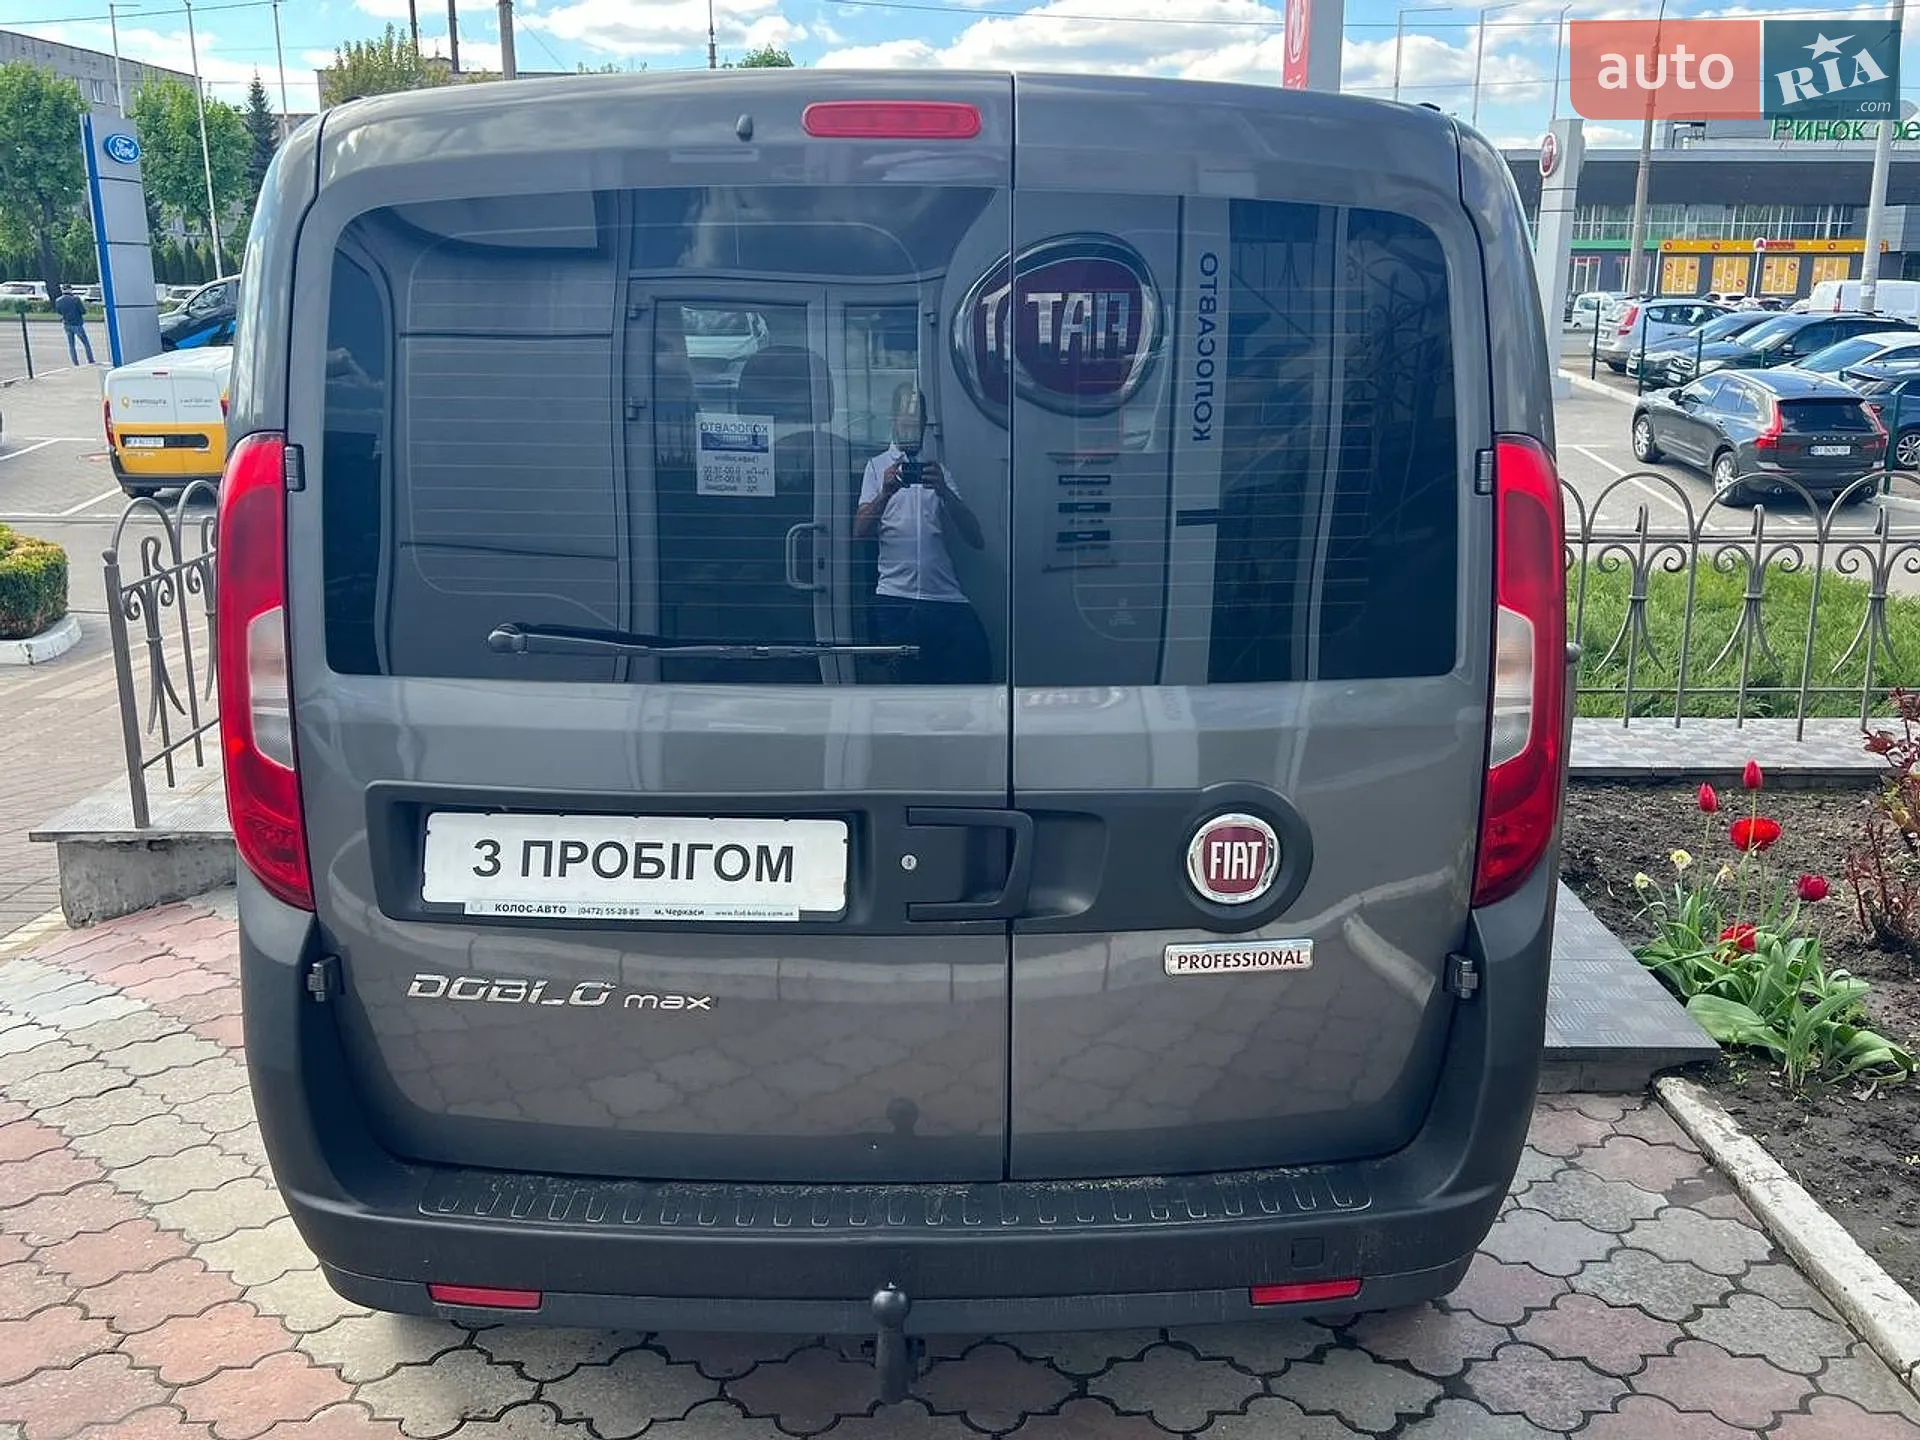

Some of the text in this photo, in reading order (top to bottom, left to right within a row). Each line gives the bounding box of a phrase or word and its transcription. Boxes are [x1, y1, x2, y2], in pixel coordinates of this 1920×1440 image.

[472, 838, 794, 883] З ПРОБІГОМ
[1210, 841, 1263, 880] FIAT
[494, 903, 568, 915] КОЛОС-АВТО
[1177, 951, 1305, 970] PROFESSIONAL
[623, 993, 712, 1011] max
